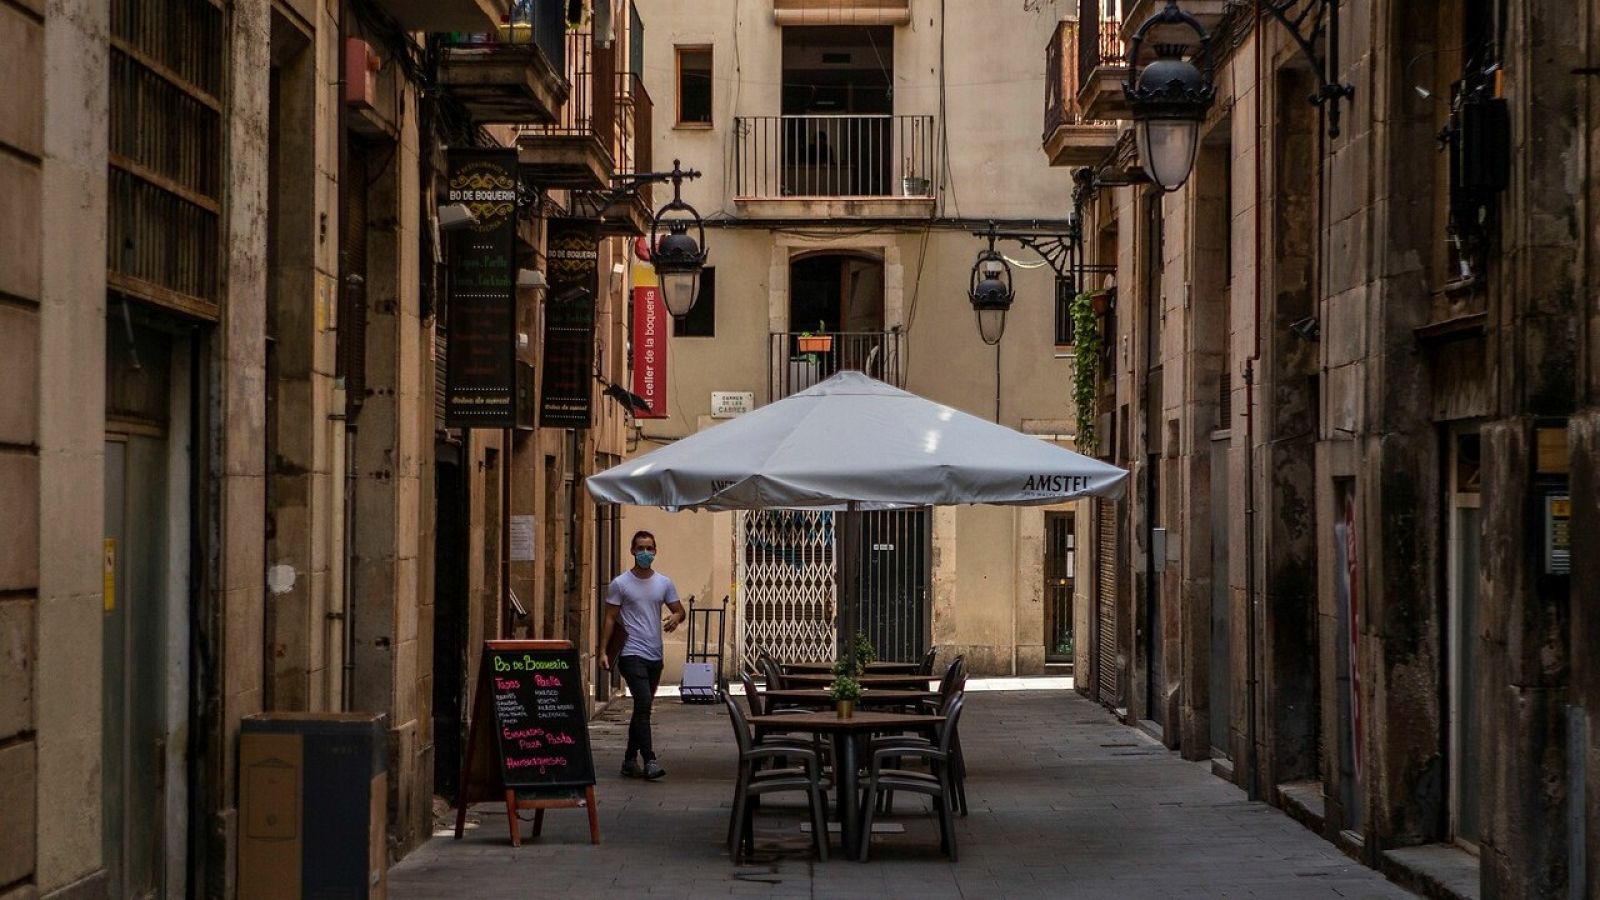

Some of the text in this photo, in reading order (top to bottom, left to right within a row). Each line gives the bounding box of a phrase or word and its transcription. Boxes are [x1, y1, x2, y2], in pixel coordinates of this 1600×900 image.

[450, 191, 516, 200] BO DE BOQUERIA
[557, 250, 565, 258] DE
[566, 250, 597, 259] BOQUERIA
[645, 290, 656, 336] boqueria
[645, 338, 655, 347] la
[645, 349, 655, 363] de
[645, 366, 655, 395] celler
[494, 656, 511, 671] Bo
